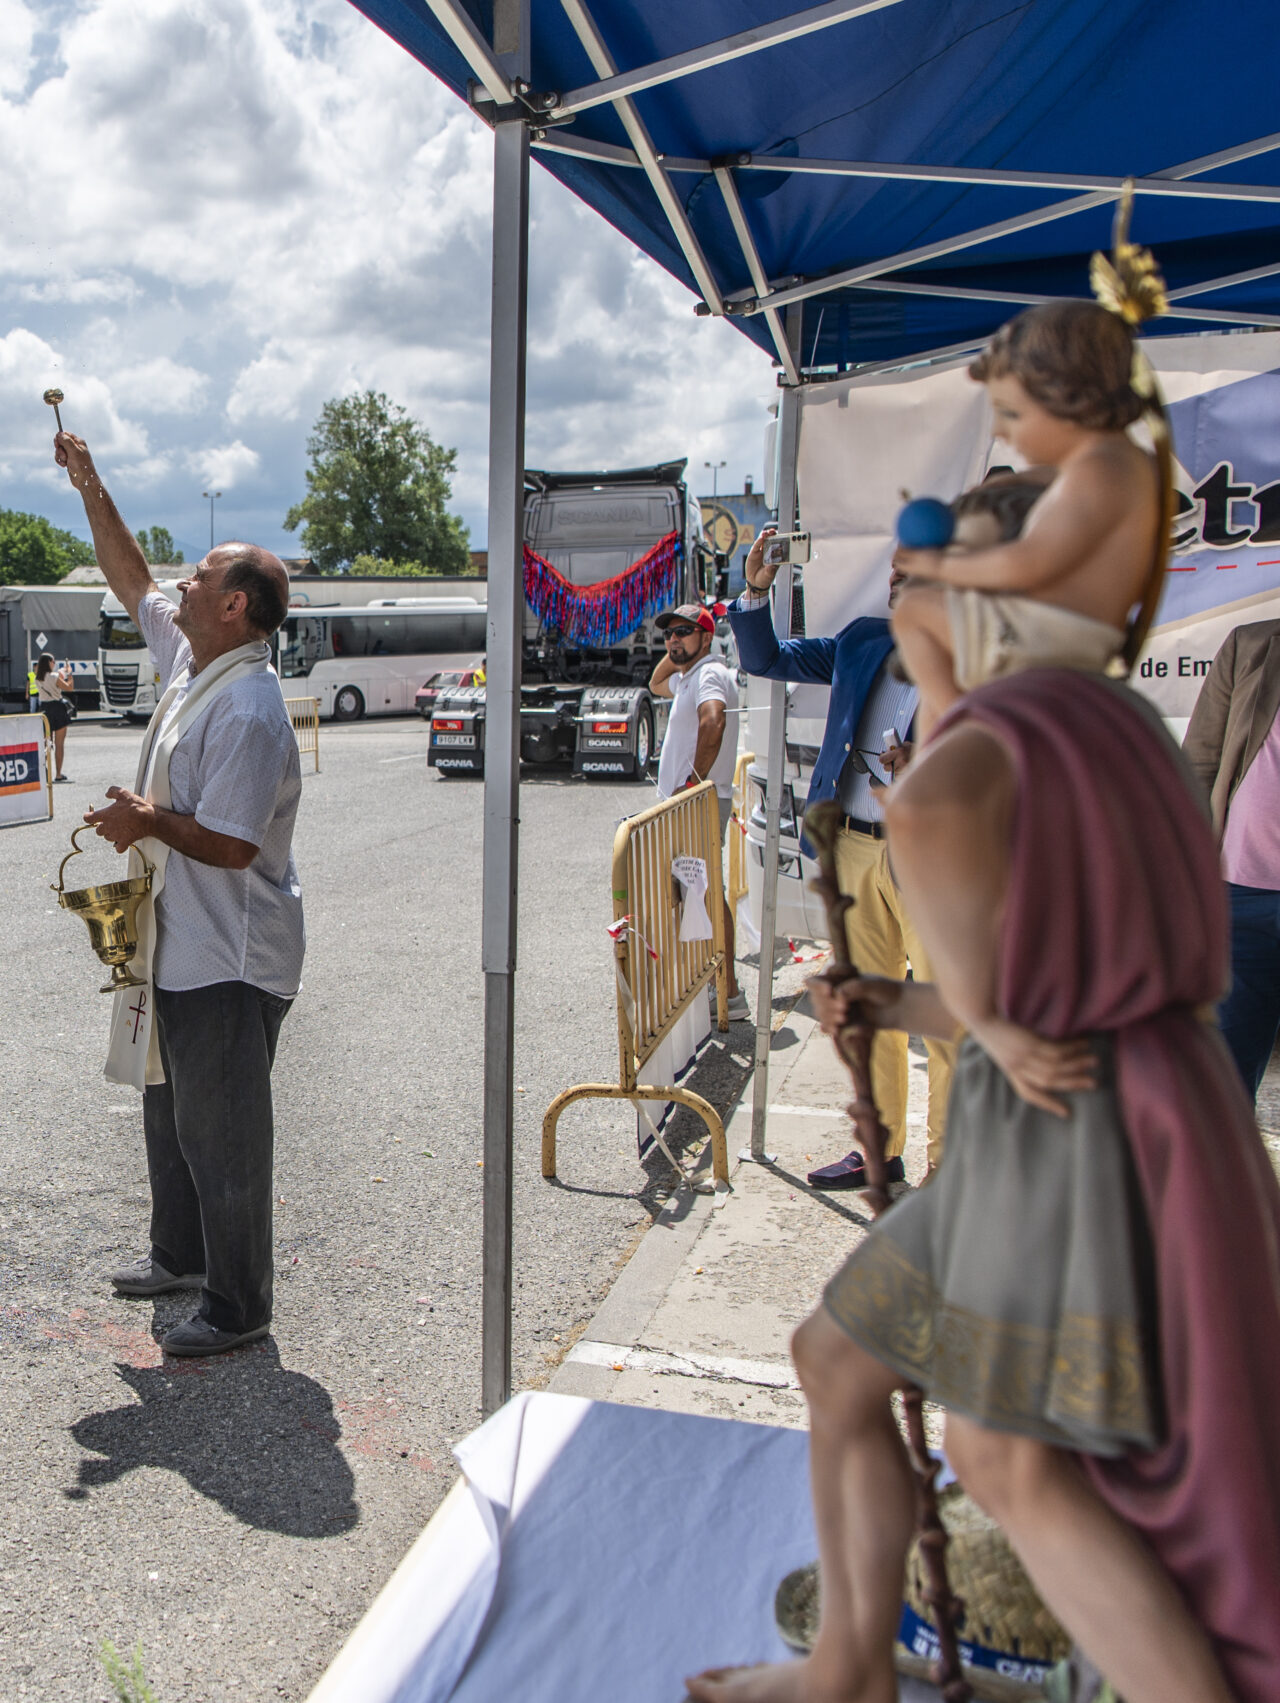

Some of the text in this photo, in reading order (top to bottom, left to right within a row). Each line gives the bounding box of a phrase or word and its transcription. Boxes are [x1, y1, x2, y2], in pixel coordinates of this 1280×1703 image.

[1140, 657, 1168, 678] de
[588, 739, 622, 747] SCANIA
[435, 758, 474, 768] SCANIA
[582, 762, 625, 771] SCANIA
